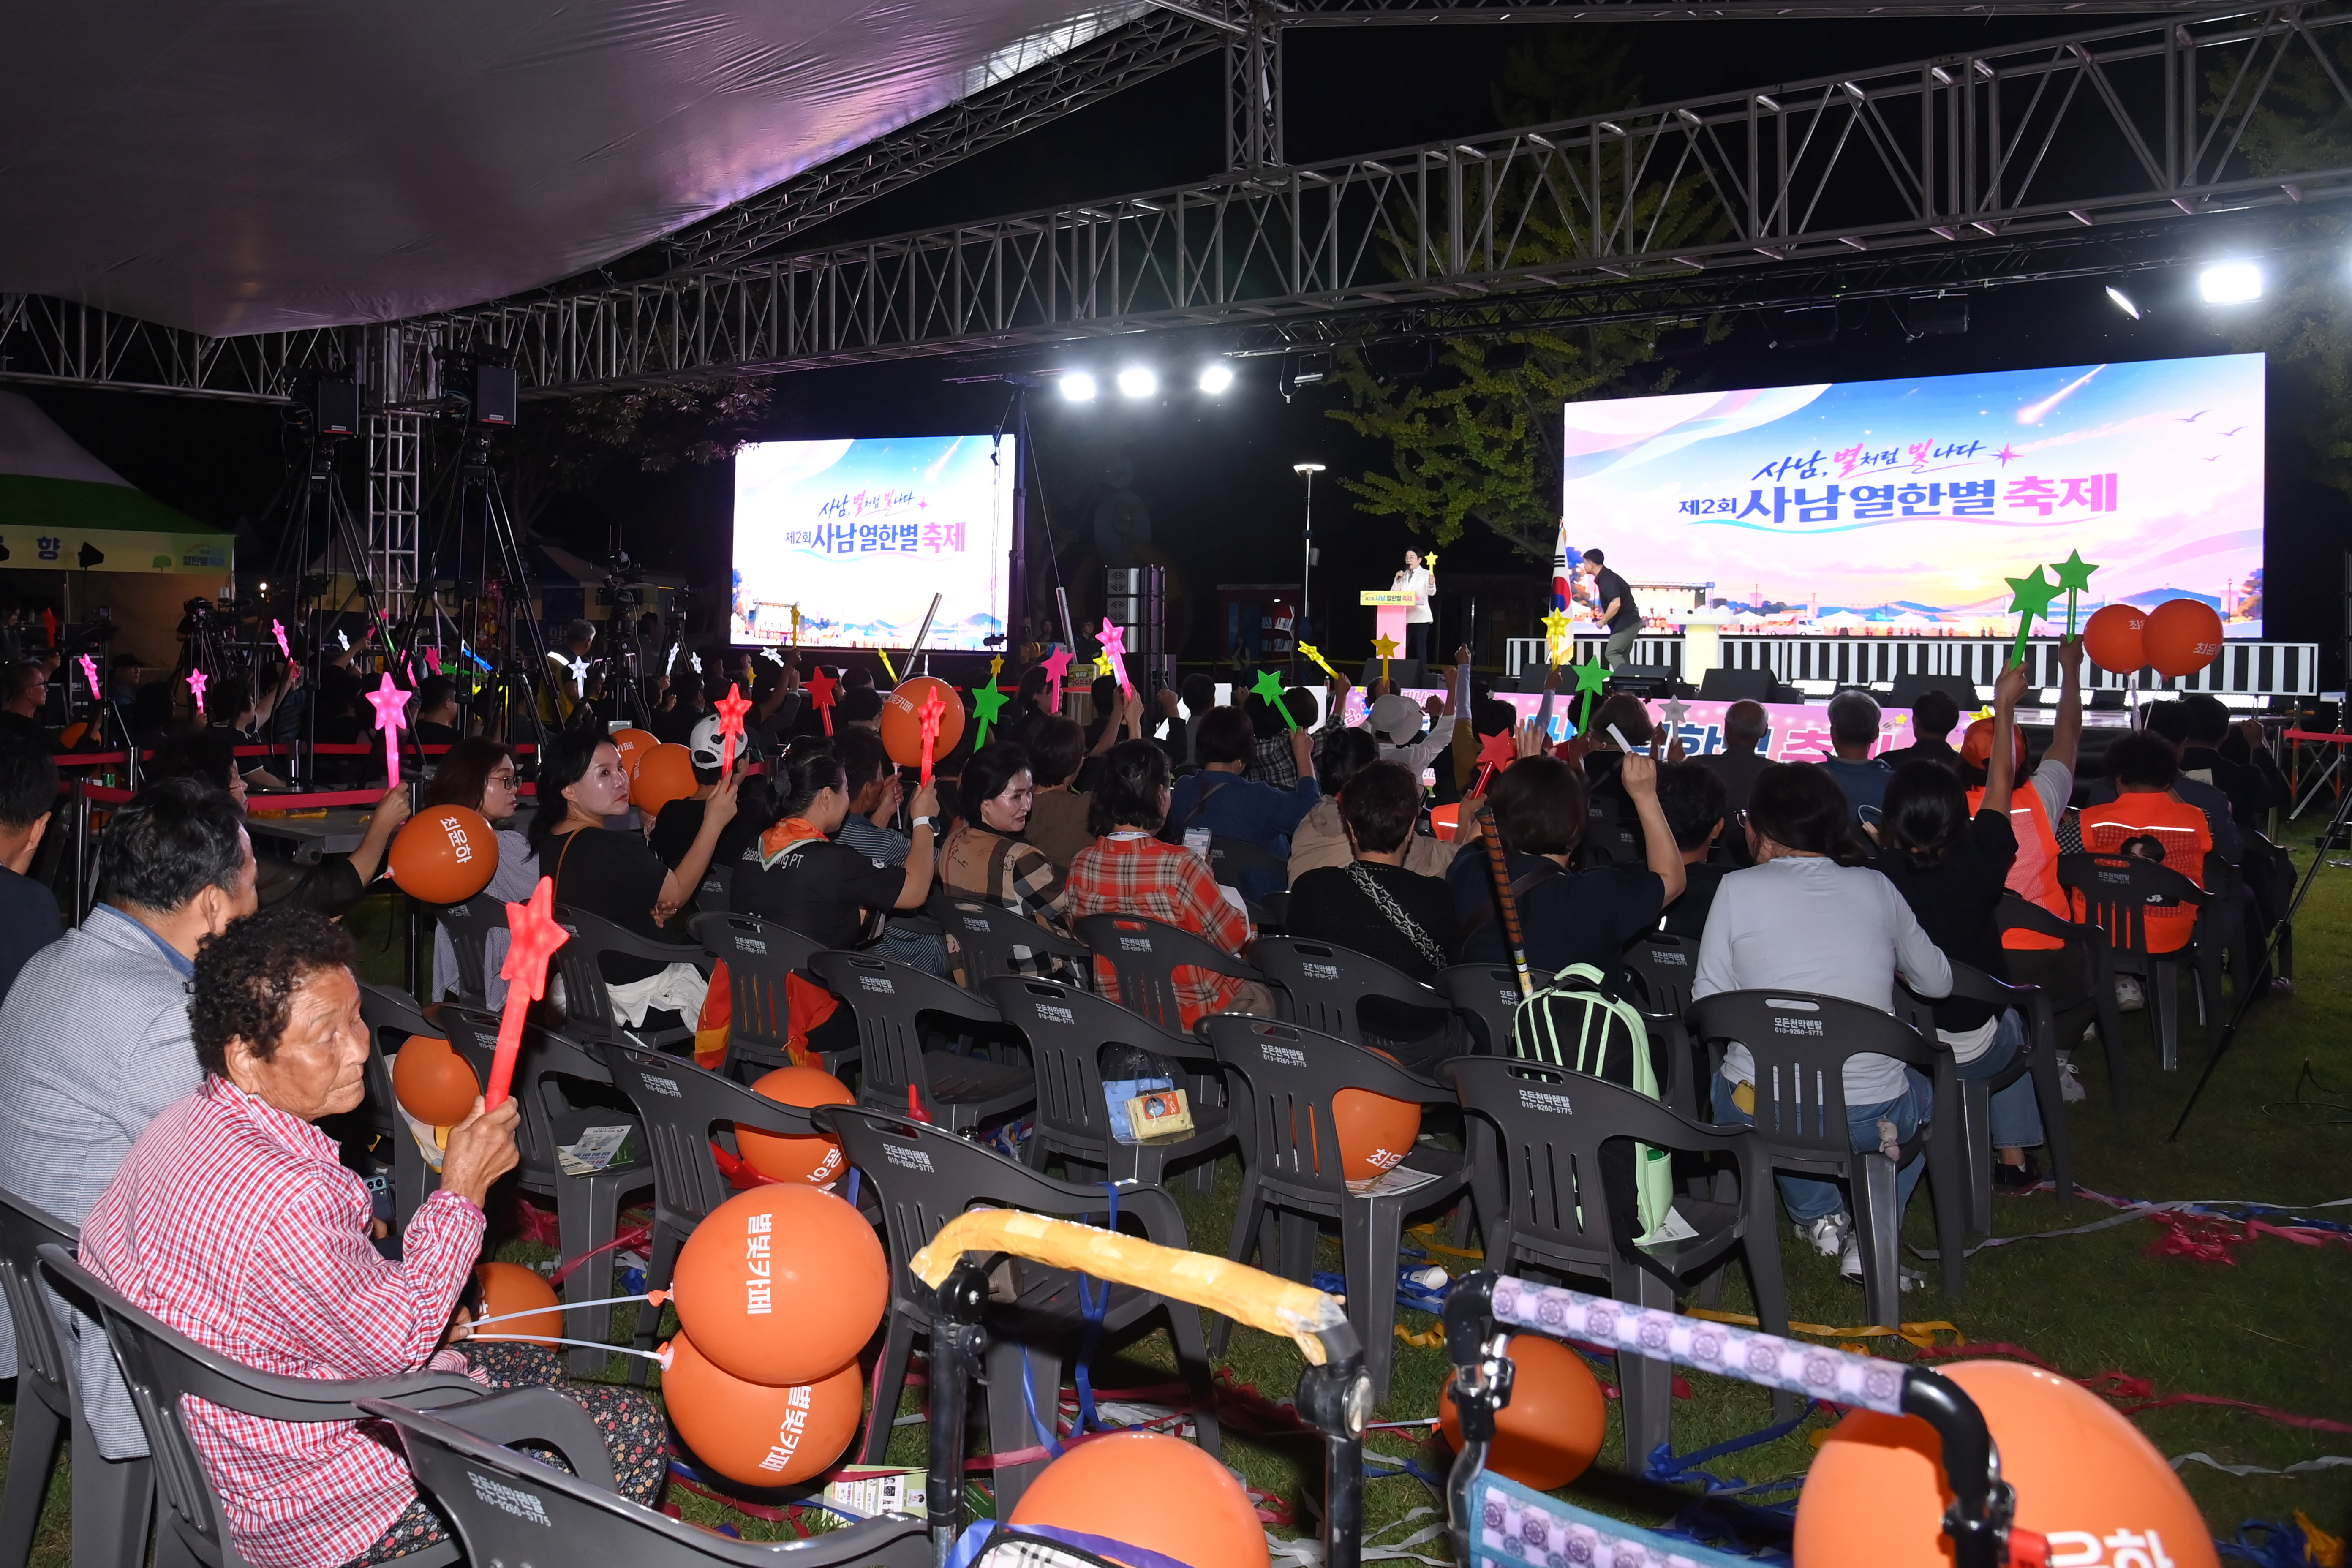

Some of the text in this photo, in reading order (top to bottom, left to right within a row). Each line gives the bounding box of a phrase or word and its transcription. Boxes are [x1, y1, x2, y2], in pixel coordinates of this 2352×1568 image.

[1751, 450, 1829, 482] 사남,
[1908, 438, 1987, 465] 빛나다
[1678, 473, 2117, 523] 제2회 사남 열한별 축제
[786, 531, 811, 544] 제2회
[921, 522, 966, 553] 축제
[440, 816, 473, 863] 최윤하
[789, 853, 804, 868] PT
[859, 976, 893, 989] 모든천막렌탈
[1036, 1003, 1073, 1019] 모든천막렌탈
[1038, 1013, 1075, 1025] 010-9260-5775
[1775, 1018, 1822, 1030] 모든천막렌탈
[1775, 1027, 1824, 1036] 010-9260-5775
[1260, 1044, 1305, 1061] 모든천막렌탈
[640, 1073, 679, 1092] 모든천막렌탈
[1519, 1089, 1571, 1108] 모든천막렌탈
[1522, 1101, 1573, 1115] 010-9260-5775
[883, 1143, 931, 1165] 모든천막렌탈
[888, 1155, 934, 1173] 010-9260-5775
[746, 1213, 773, 1315] 별빛카페
[759, 1386, 812, 1472] 별빛카페
[467, 1471, 545, 1515] 모든천막렌탈
[476, 1489, 552, 1527] 010-9260-5775
